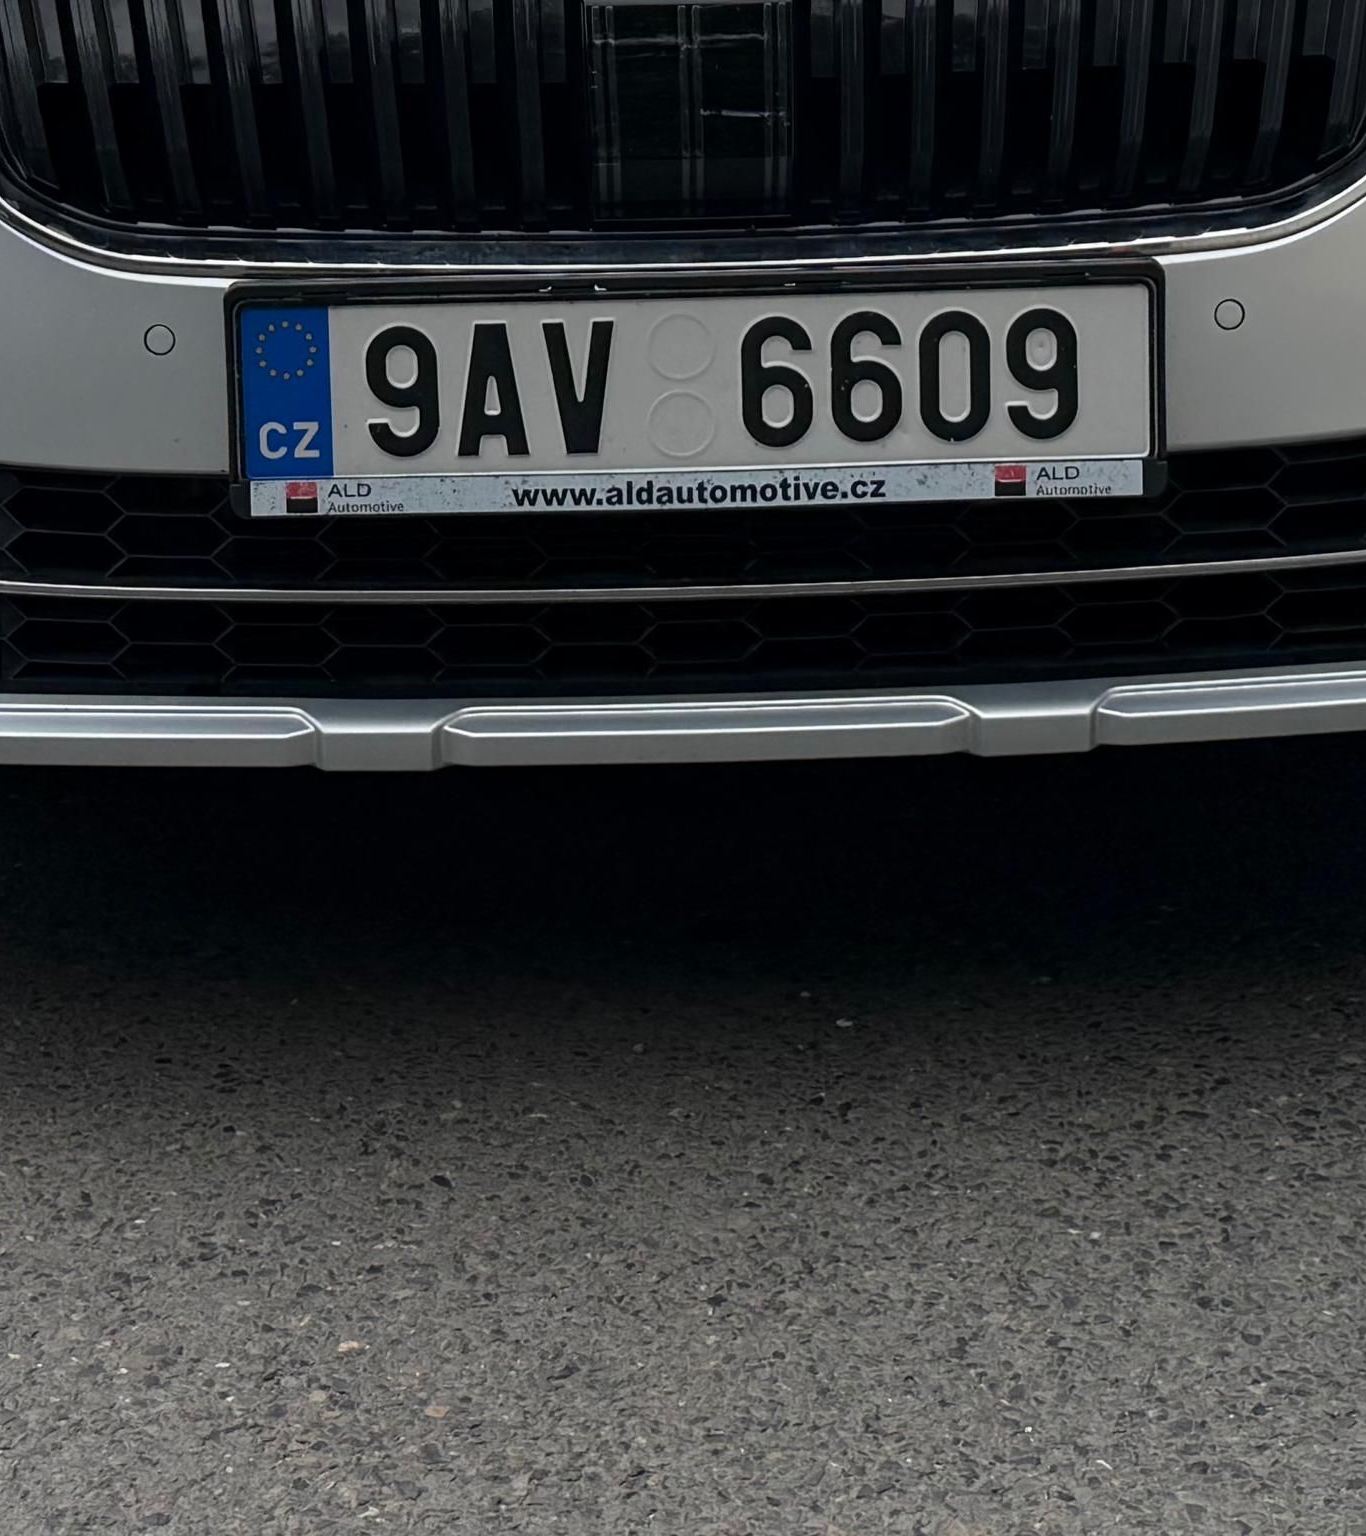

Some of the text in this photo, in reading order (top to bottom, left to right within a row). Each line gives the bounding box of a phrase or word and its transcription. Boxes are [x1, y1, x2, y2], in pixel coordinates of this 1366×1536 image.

[365, 308, 1079, 458] 9AV 6609
[258, 421, 321, 460] CZ
[1036, 466, 1080, 480] ALD
[327, 483, 373, 498] ALD
[512, 477, 886, 507] www.aldautomotive.cz
[1036, 484, 1112, 496] Automotive
[327, 500, 404, 513] Automotive
